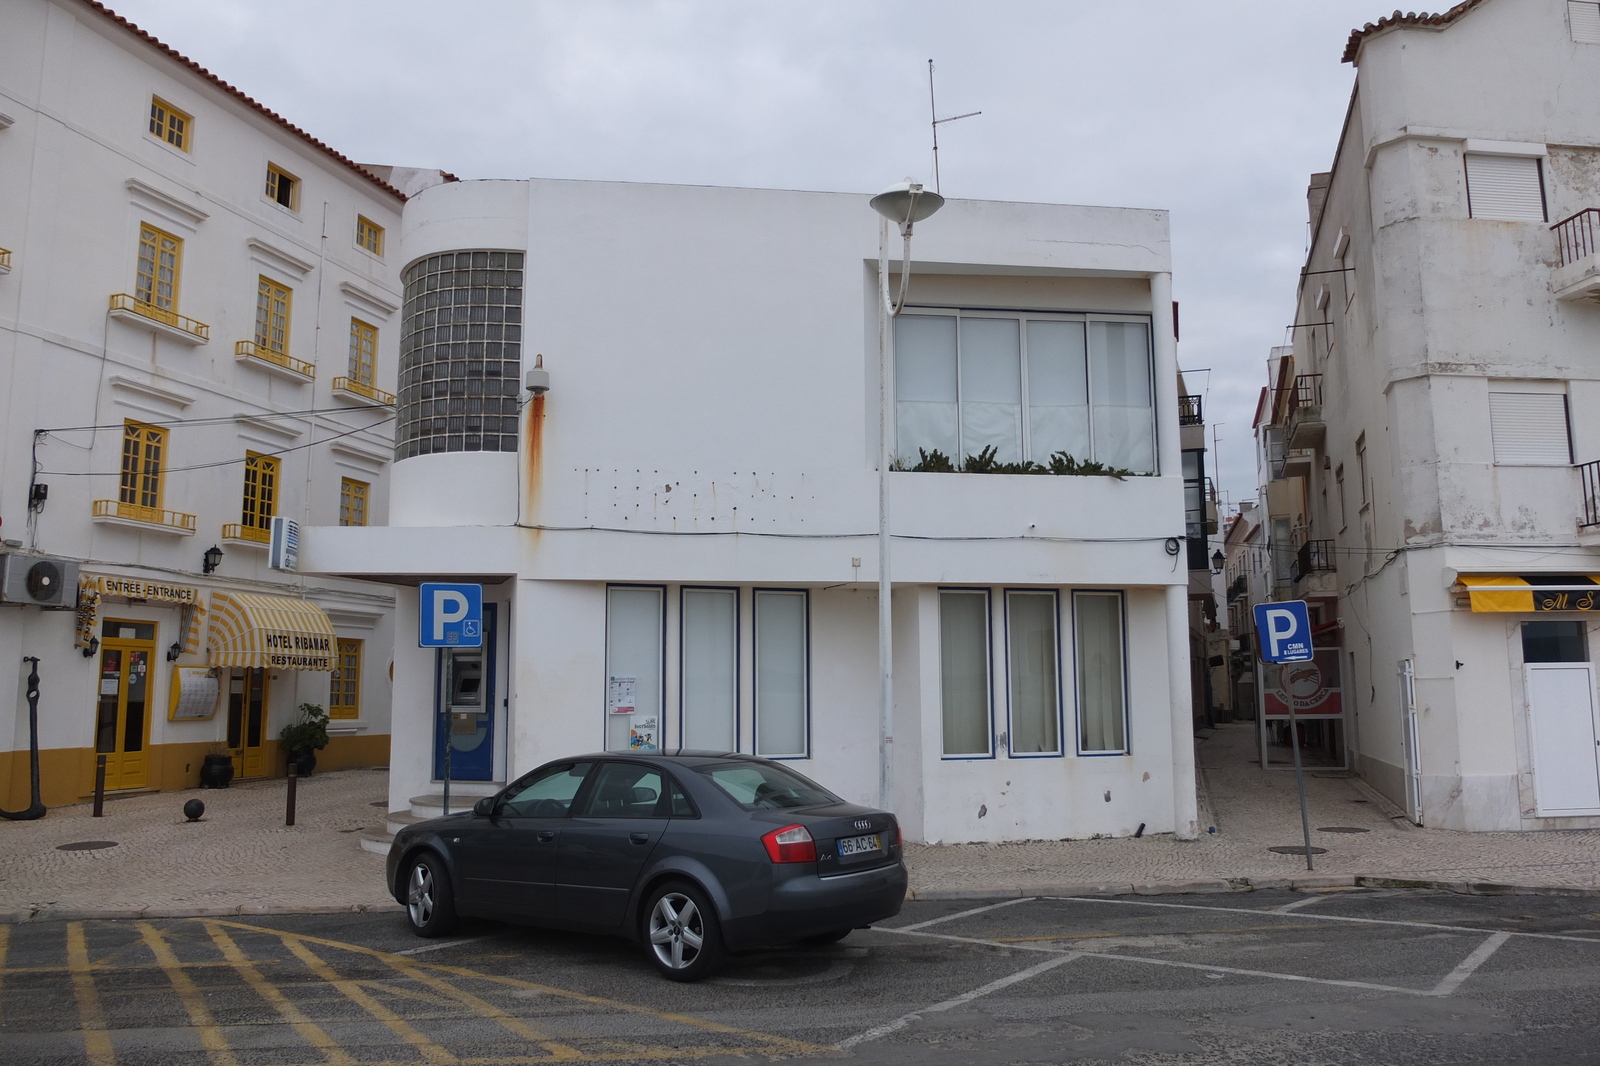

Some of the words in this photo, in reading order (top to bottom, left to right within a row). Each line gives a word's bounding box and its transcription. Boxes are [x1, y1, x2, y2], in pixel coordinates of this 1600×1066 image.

[106, 580, 141, 594] ENTRÉE
[147, 585, 192, 600] ENTRANCE
[434, 590, 469, 640] P
[1266, 609, 1297, 657] P
[266, 634, 293, 649] HOTEL
[295, 636, 330, 651] RIBAMAR
[271, 655, 328, 667] RESTAURANTE
[1276, 689, 1299, 706] LEIO
[1309, 689, 1330, 705] CERCA
